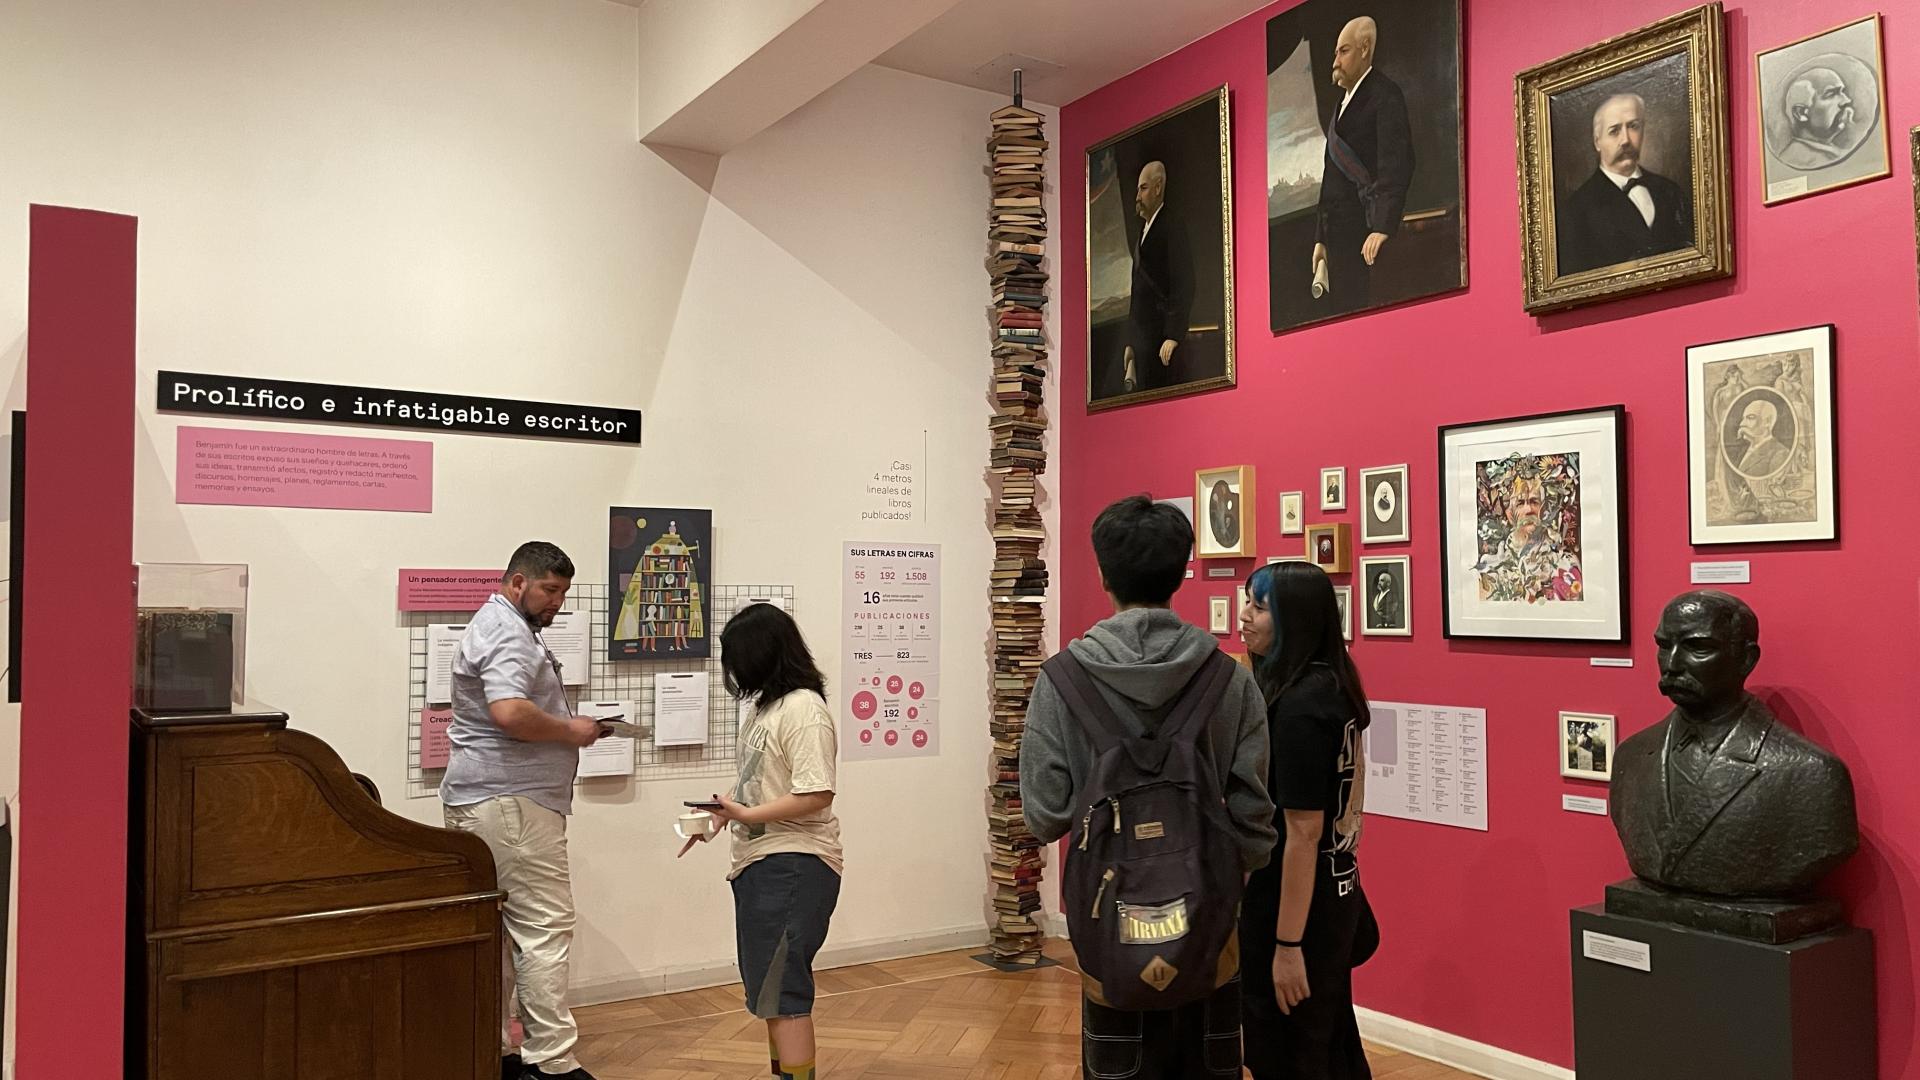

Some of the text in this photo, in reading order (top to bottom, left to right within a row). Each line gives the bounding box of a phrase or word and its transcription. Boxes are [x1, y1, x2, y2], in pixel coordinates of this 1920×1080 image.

[174, 382, 627, 434] Prolífico e infatigable escritor
[262, 446, 315, 455] extraordinario
[316, 448, 346, 456] hombre
[346, 449, 357, 457] de
[224, 453, 255, 461] escritos
[256, 455, 286, 464] expuso
[301, 457, 329, 466] sueños
[382, 462, 408, 470] ordenó
[890, 460, 912, 472] ¡Casi
[211, 462, 233, 470] ideas,
[236, 464, 276, 472] transmitió
[278, 466, 308, 475] afectos,
[309, 468, 338, 477] registró
[345, 469, 374, 478] redactó
[194, 472, 236, 482] discursos,
[238, 474, 283, 486] homenajes,
[284, 476, 310, 486] planes,
[313, 478, 361, 488] reglamentos,
[874, 472, 912, 484] 4 metros
[194, 484, 235, 492] memorias
[866, 485, 912, 496] lineales de
[888, 498, 912, 508] libros
[861, 510, 912, 521] publicados!
[850, 548, 934, 559] SUS LETRAS EN CIFRAS
[421, 576, 457, 584] pensador
[458, 576, 502, 585] contingente
[854, 570, 927, 581] 55 192 1.508
[863, 590, 881, 605] 16
[884, 709, 900, 718] 192
